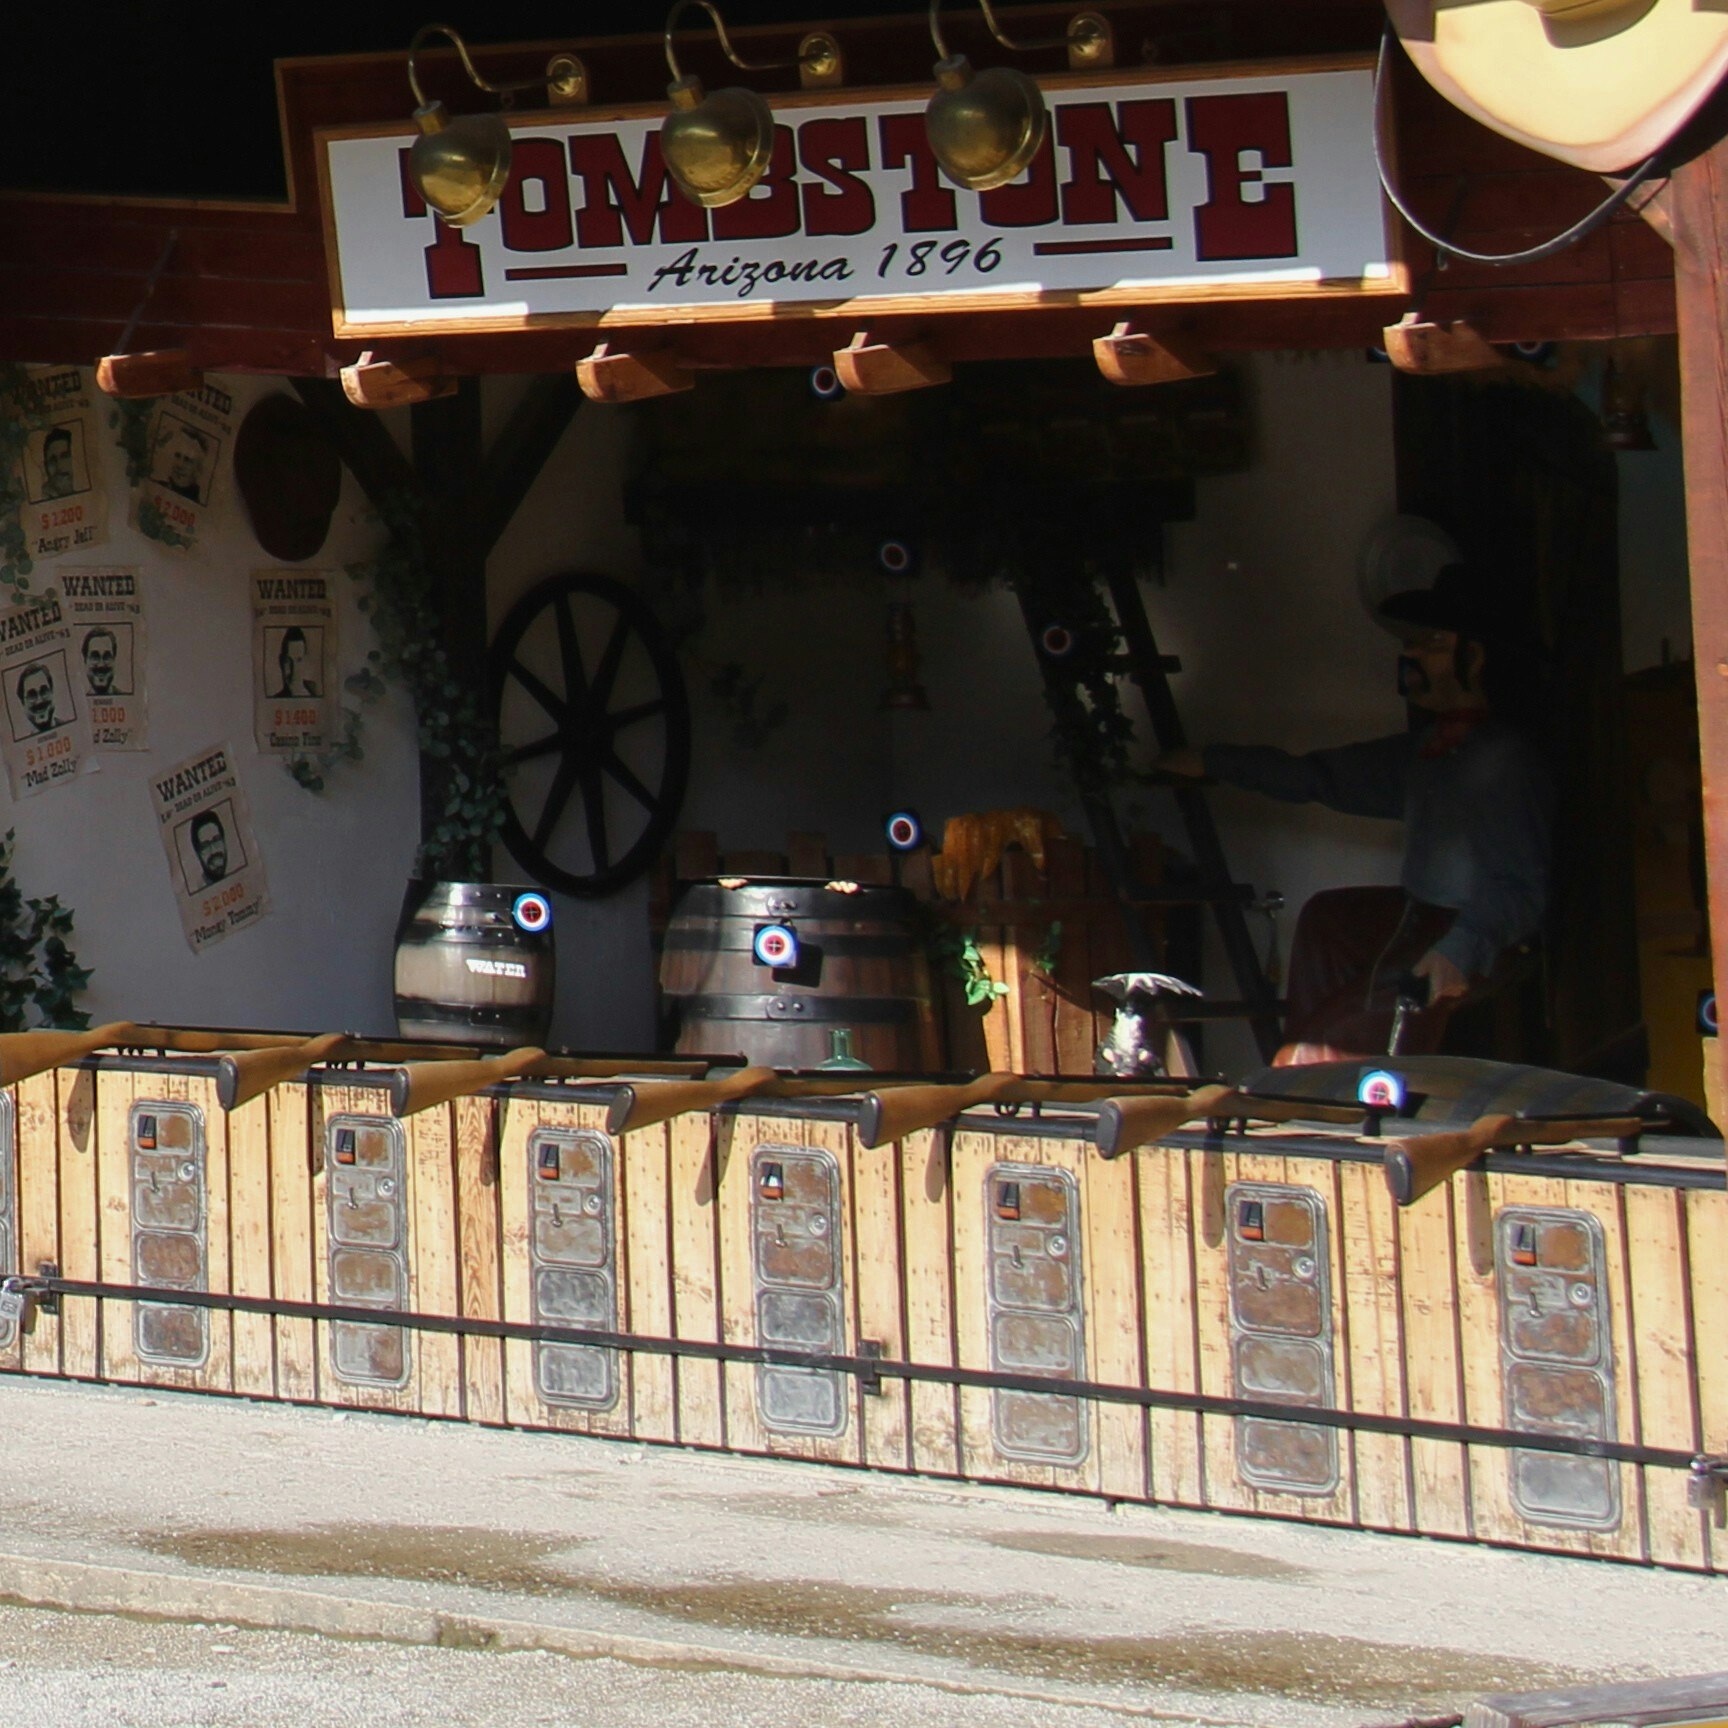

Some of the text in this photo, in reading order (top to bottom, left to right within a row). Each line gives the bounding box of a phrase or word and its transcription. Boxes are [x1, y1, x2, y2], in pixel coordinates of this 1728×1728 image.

[647, 236, 1004, 297] Arizona 1896
[62, 574, 136, 597] WANTED
[256, 578, 327, 600] WANTED
[155, 751, 228, 803] WANTED
[466, 958, 527, 978] WATER
